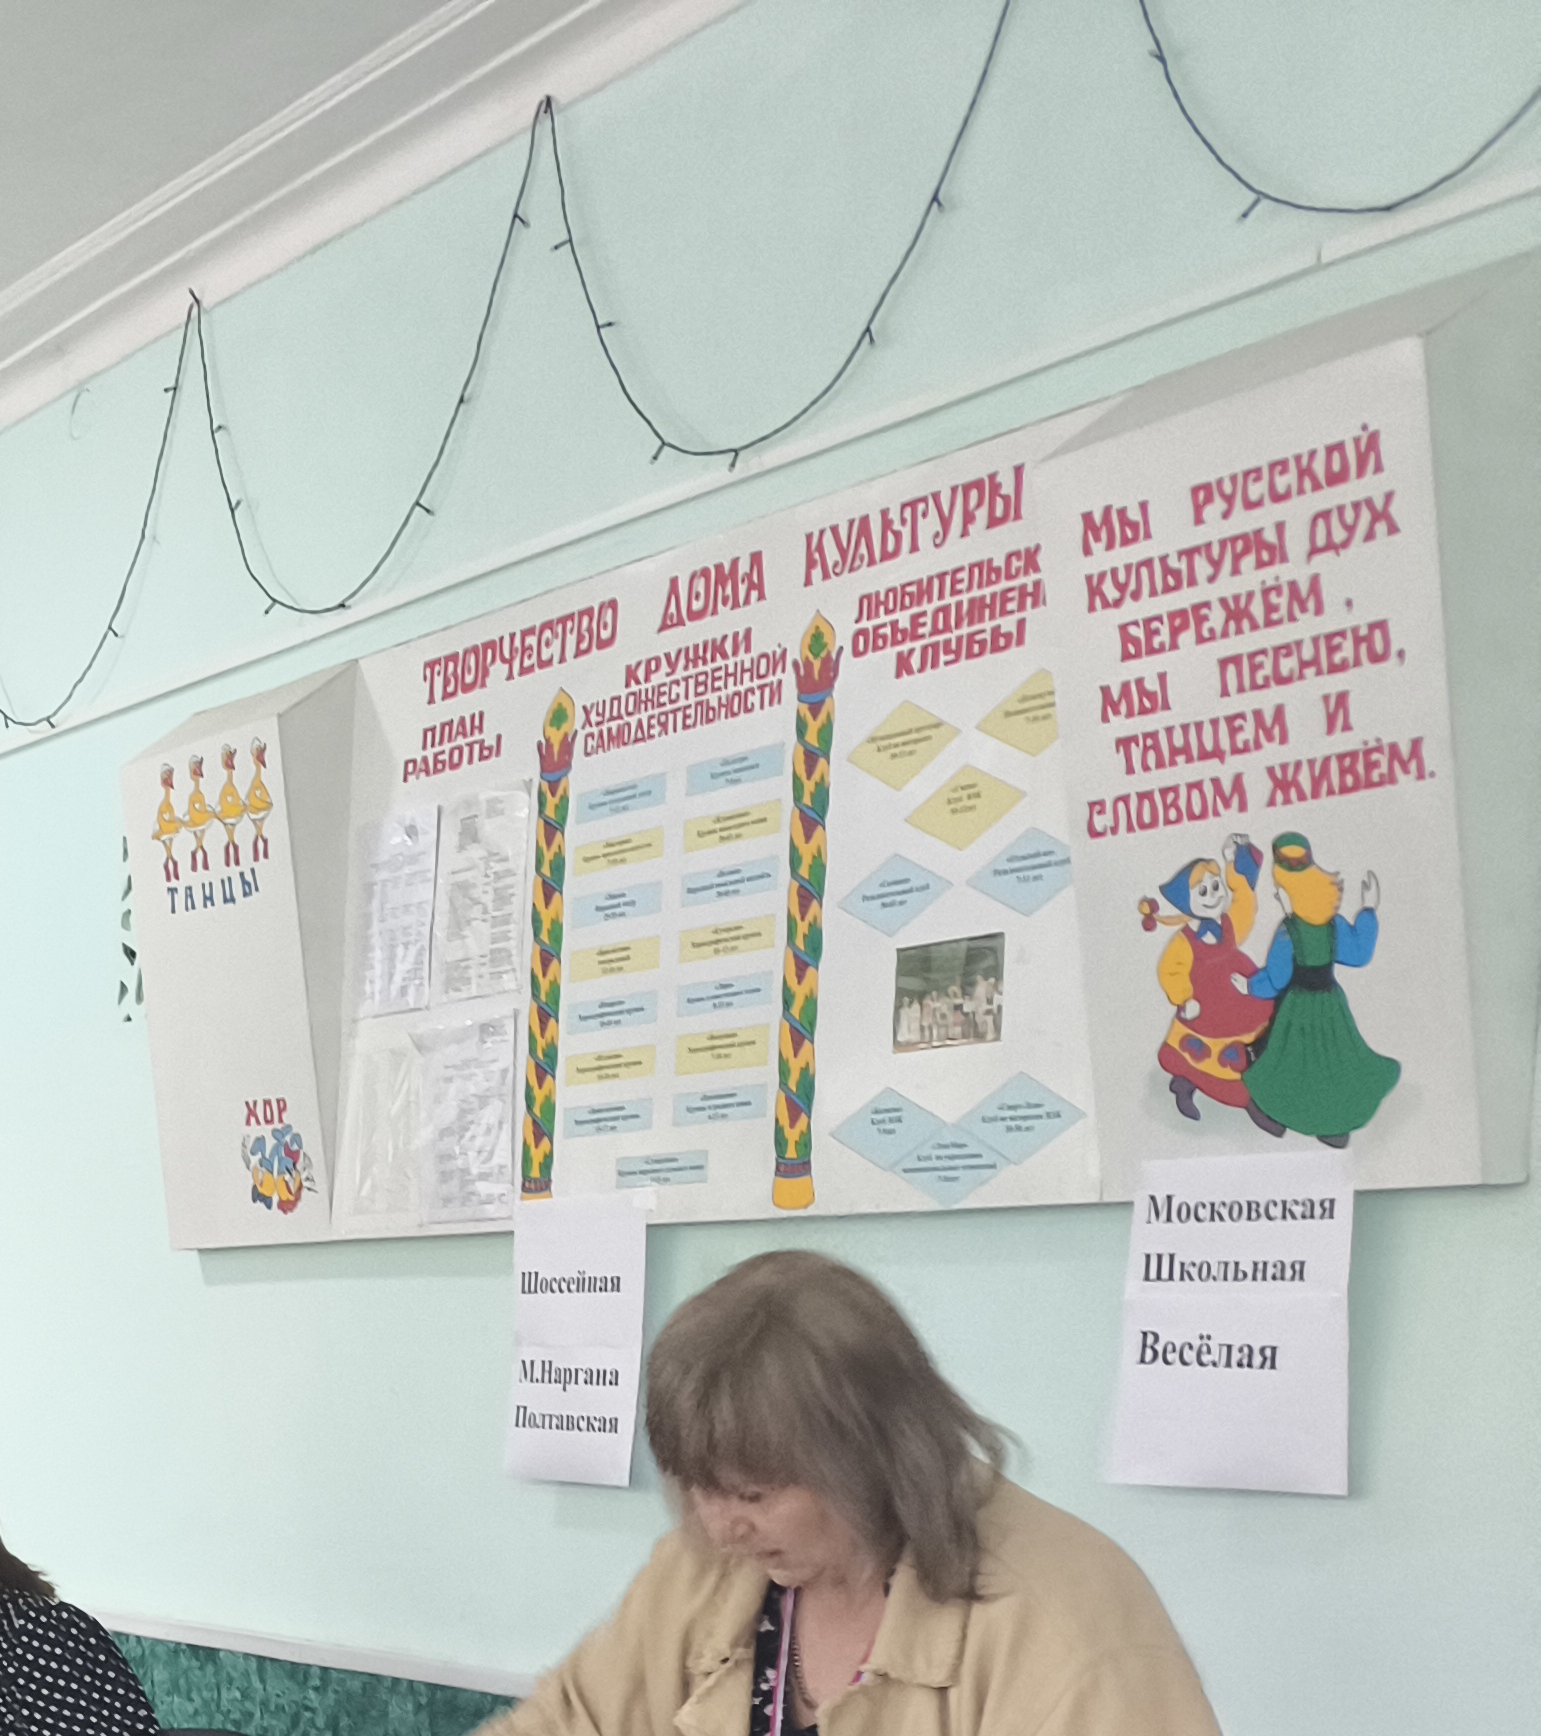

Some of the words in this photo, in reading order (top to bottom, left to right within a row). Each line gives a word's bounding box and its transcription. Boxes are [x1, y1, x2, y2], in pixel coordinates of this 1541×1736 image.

[1080, 500, 1153, 557] МЫ
[1190, 423, 1385, 526] РУССКОЙ
[1084, 520, 1290, 614] КУЛЬТУРЫ
[1306, 490, 1402, 564] ДУХ
[422, 597, 618, 705] ТВОРЧЕСТВО
[657, 550, 767, 633] ДОМА
[803, 463, 1026, 588] КУЛЬТУРЫ
[851, 578, 1047, 659] ОБЪЕДИНЕН
[894, 616, 1027, 680] КЛУБЫ
[581, 643, 788, 730] ХУДОЖЕСТВЕННОЙ
[624, 626, 753, 689] КРУЖКИ
[1099, 671, 1172, 724] МЫ
[1217, 618, 1407, 698] ПЕСНЕЮ,
[421, 709, 485, 751] ПЛАН
[583, 678, 783, 758] САМОДЕЯТЕЛЬНОСТИ
[1115, 703, 1289, 775] ТАНЦЕМ
[1321, 689, 1354, 737] И
[402, 733, 503, 784] РАБОТЫ
[1086, 772, 1249, 839] СЛОВОМ
[1265, 736, 1437, 808] ЖИВЁМ.
[166, 867, 261, 915] ТАНЦЫ
[244, 1097, 288, 1128] ХОР
[1144, 1192, 1337, 1227] Московская
[520, 1269, 622, 1295] Шоссейная
[1141, 1250, 1308, 1285] Школьная
[1137, 1329, 1279, 1372] Весёлая
[514, 1404, 619, 1434] Полтавская
